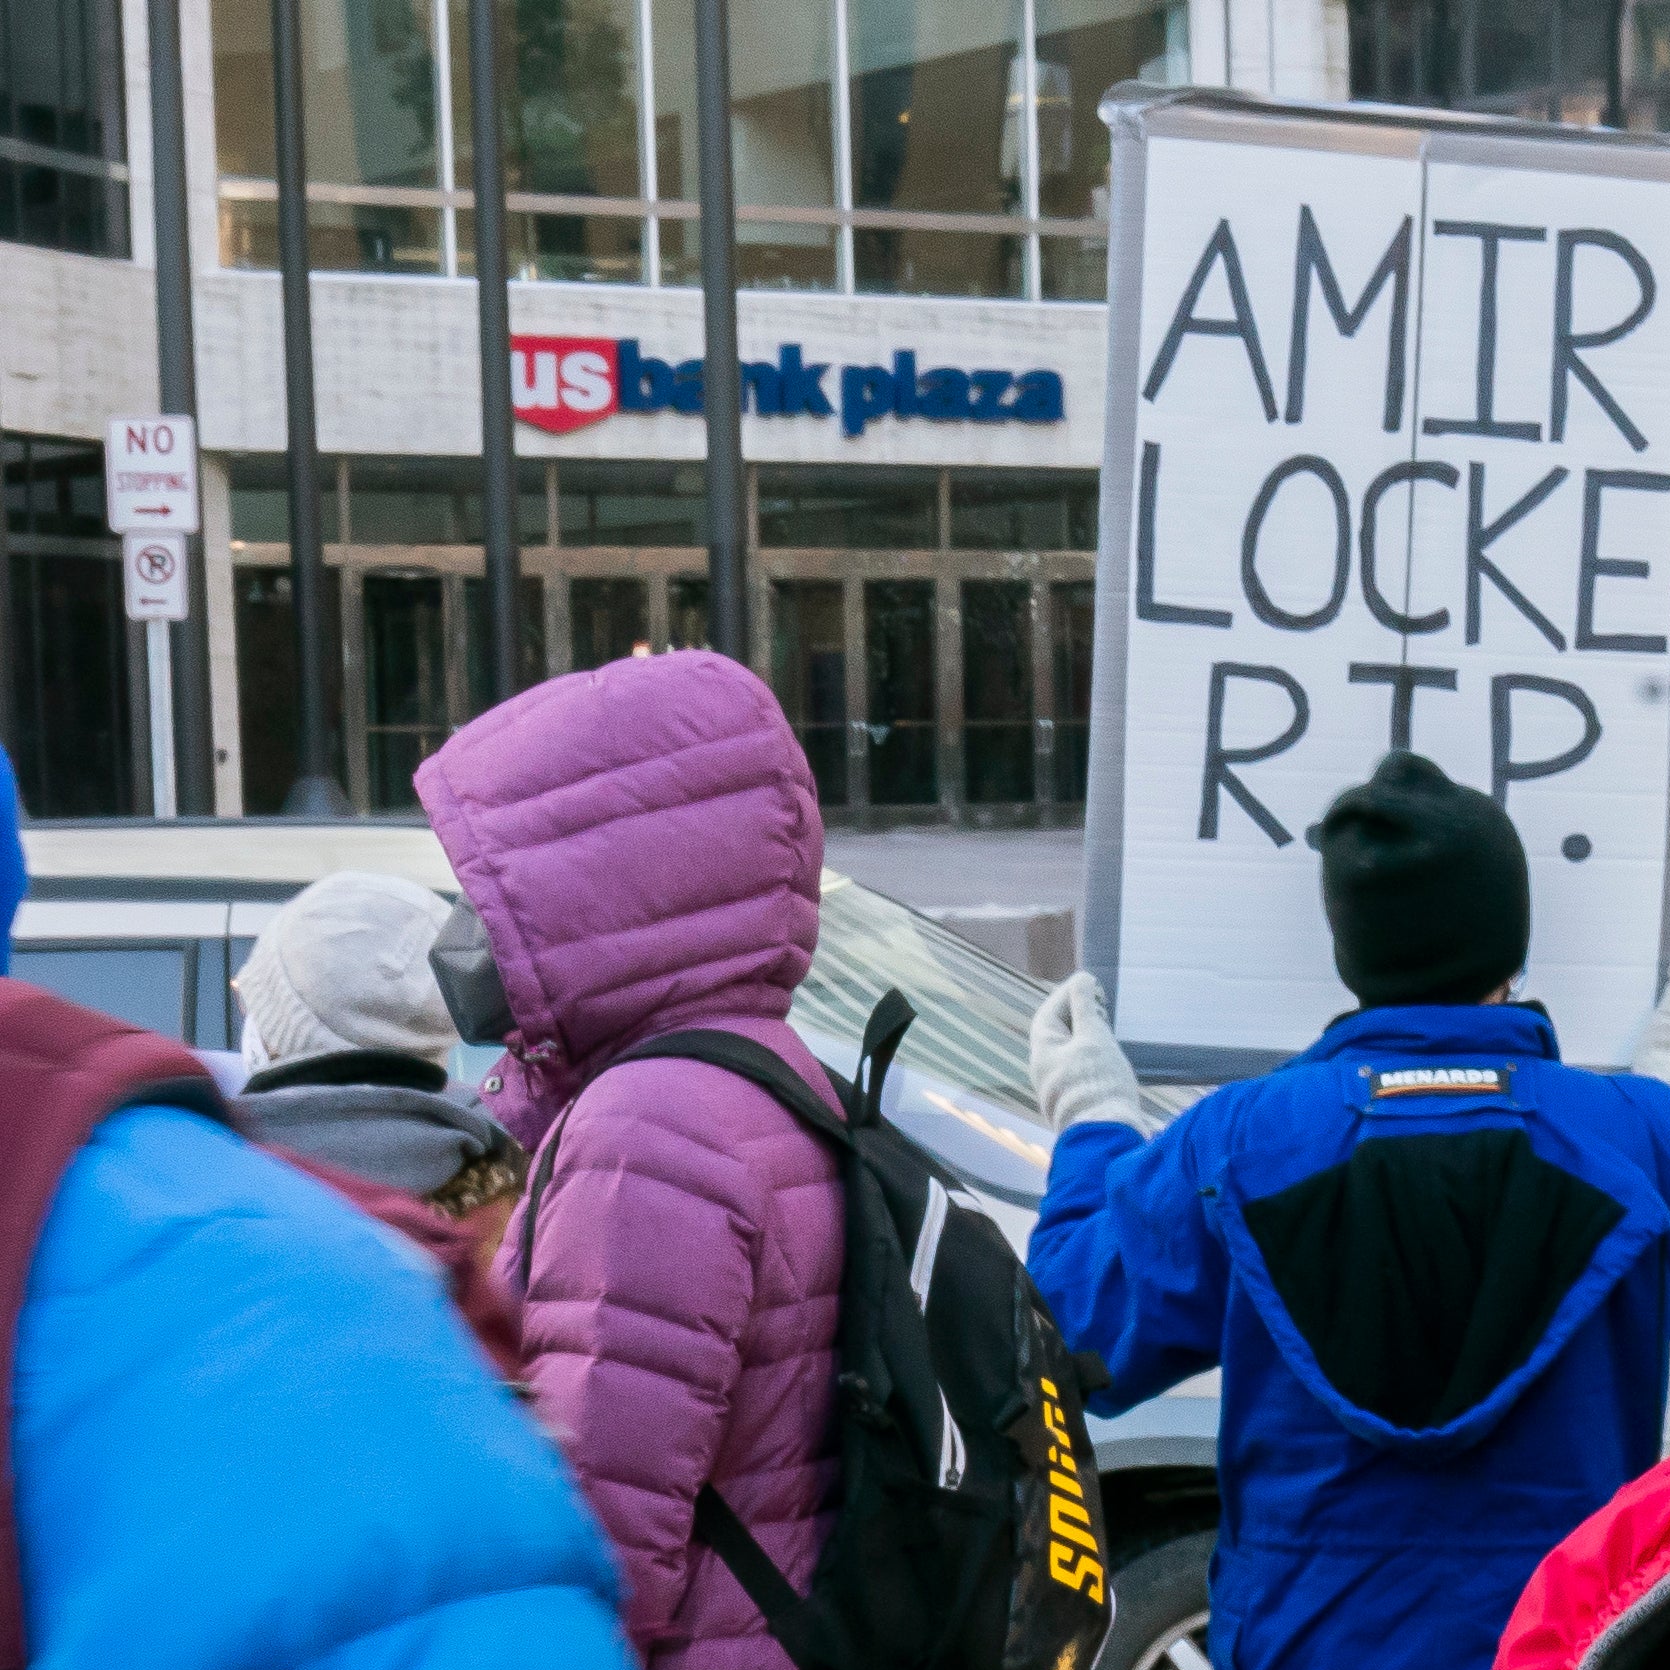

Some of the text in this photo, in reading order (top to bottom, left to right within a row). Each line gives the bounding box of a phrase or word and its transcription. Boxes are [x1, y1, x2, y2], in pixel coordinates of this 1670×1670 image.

[1143, 203, 1657, 453] AMIR
[511, 338, 1065, 438] us bank plaza
[126, 424, 174, 453] NO
[1380, 1069, 1498, 1087] MENARDS
